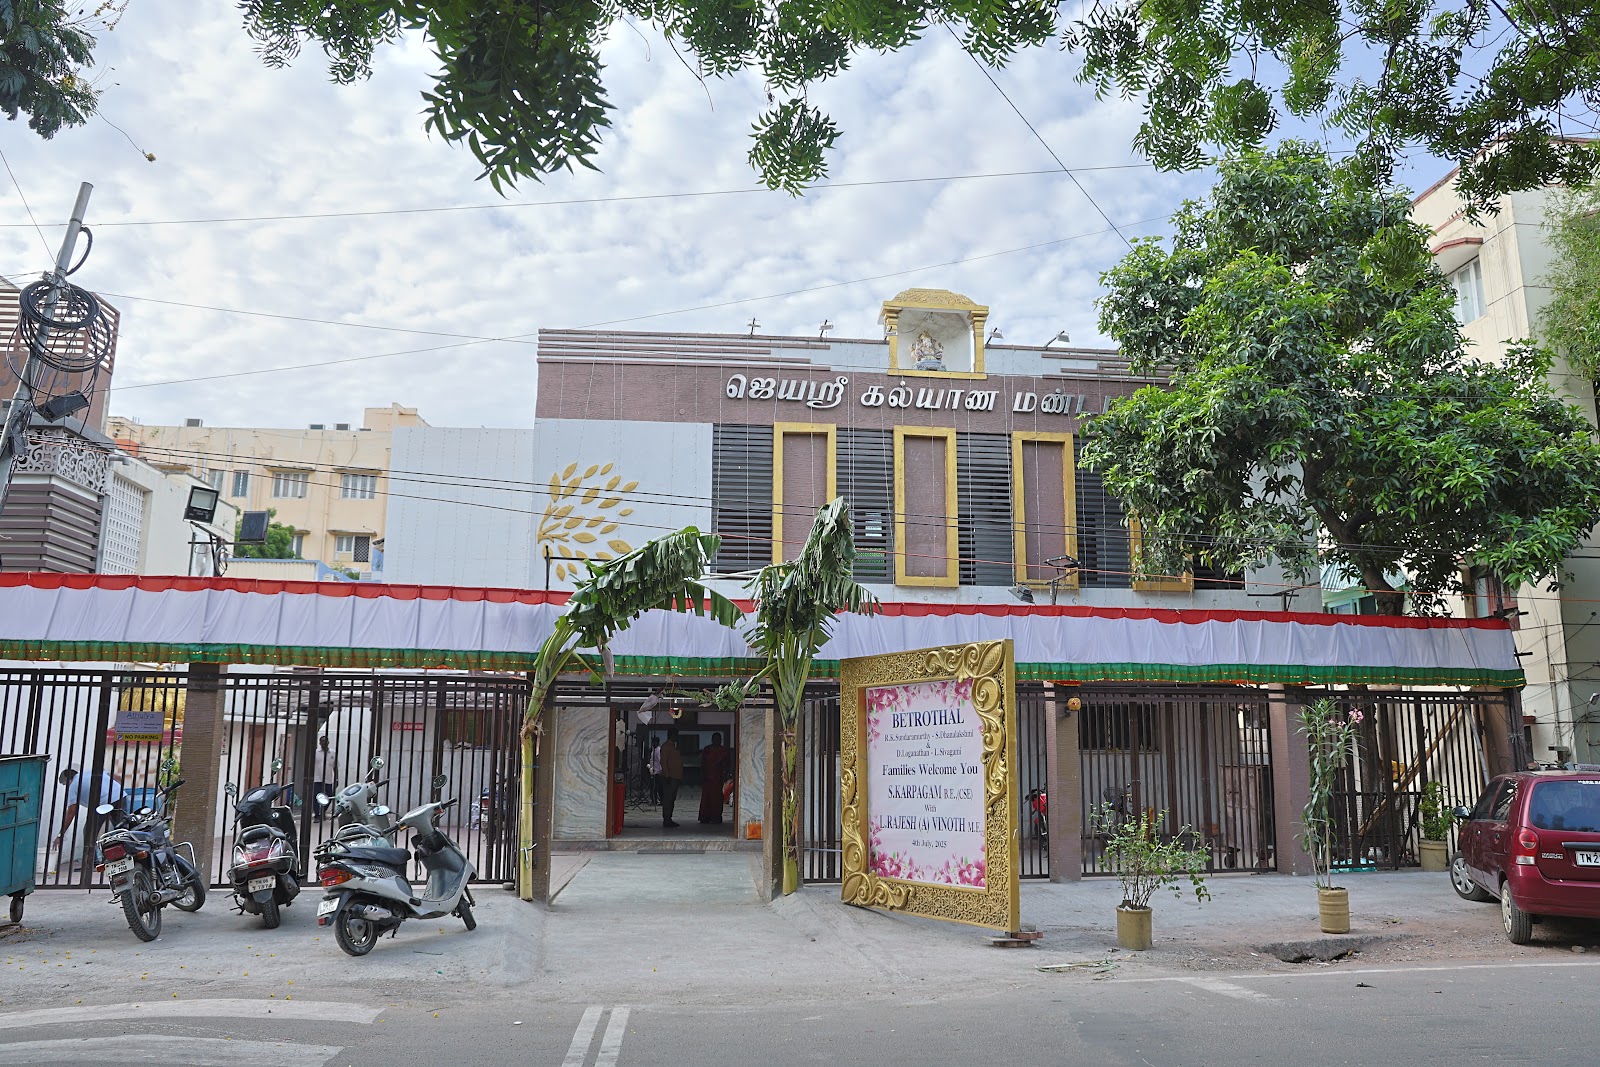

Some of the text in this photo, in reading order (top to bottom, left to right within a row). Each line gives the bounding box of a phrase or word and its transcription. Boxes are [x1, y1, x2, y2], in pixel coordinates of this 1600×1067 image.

[892, 708, 965, 729] BETROTHAL
[882, 763, 978, 776] Families Welcome You
[888, 784, 942, 799] S.KARPAGAM
[924, 804, 937, 812] With
[880, 815, 917, 830] L.RAJESH
[918, 817, 930, 833] (A)
[932, 816, 966, 832] VINOTH
[912, 839, 947, 848] 4th July, 2025
